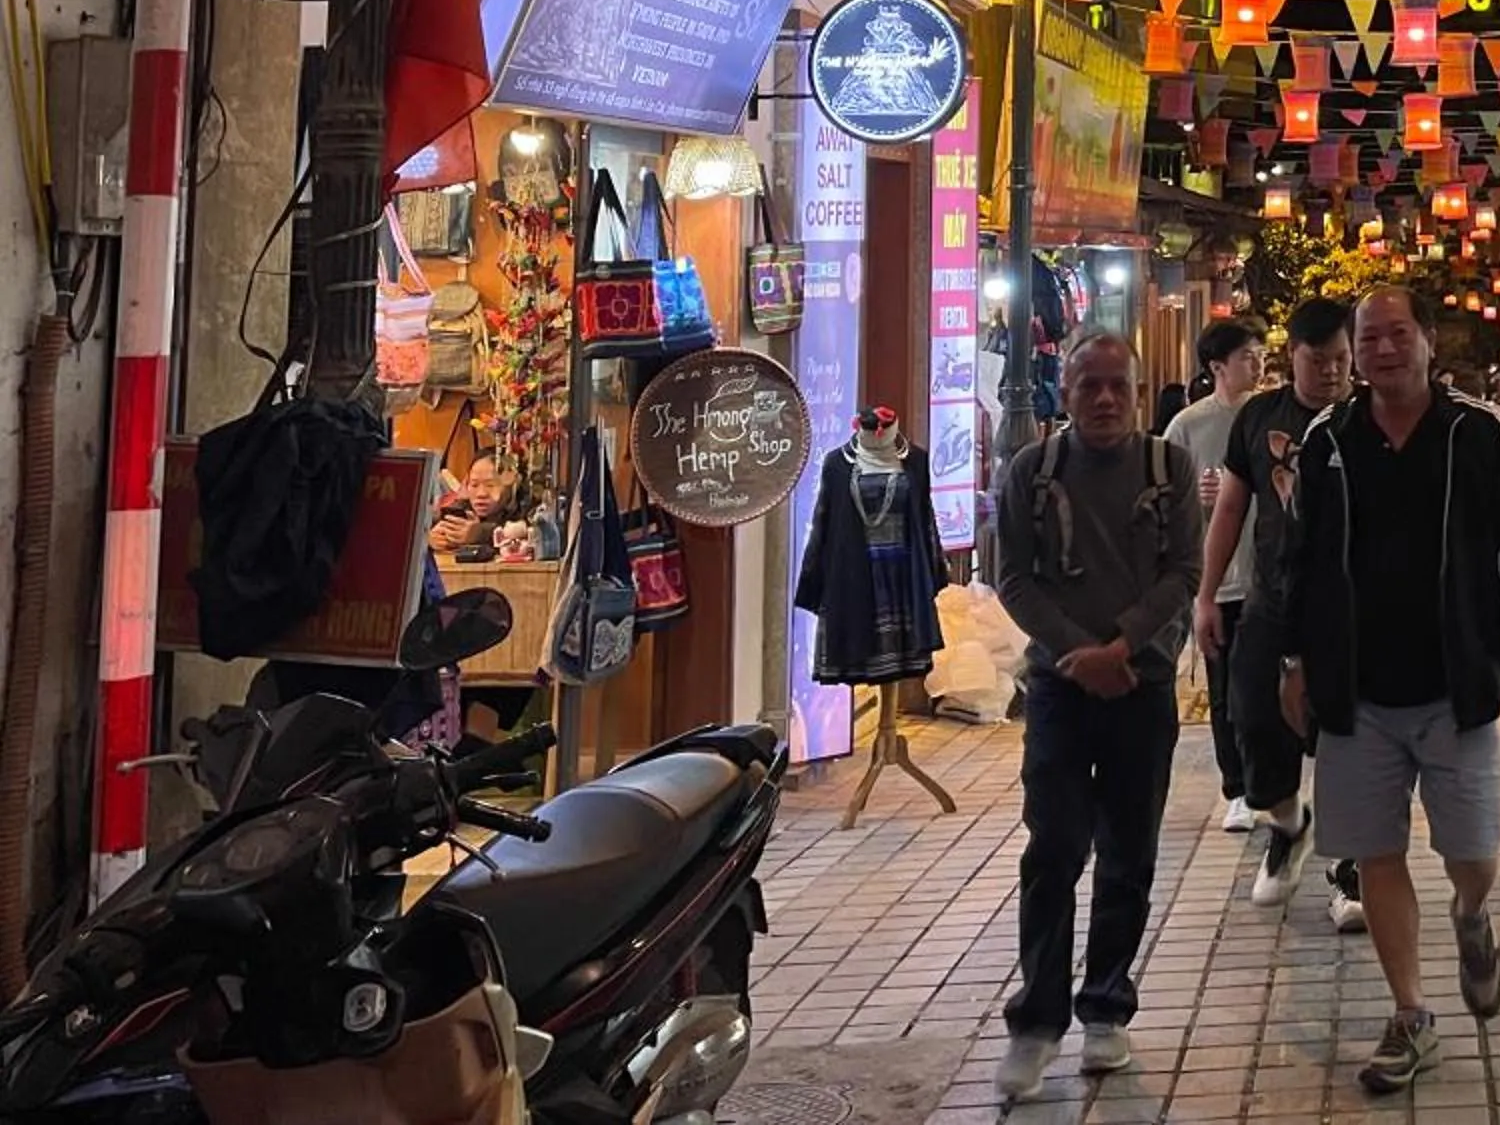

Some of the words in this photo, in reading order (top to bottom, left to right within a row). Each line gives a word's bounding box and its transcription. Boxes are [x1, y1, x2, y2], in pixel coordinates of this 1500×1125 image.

[817, 162, 853, 188] SALT
[805, 199, 863, 227] COFFEE
[650, 402, 687, 438] The
[675, 442, 740, 482] Hemp
[749, 429, 792, 466] Shop
